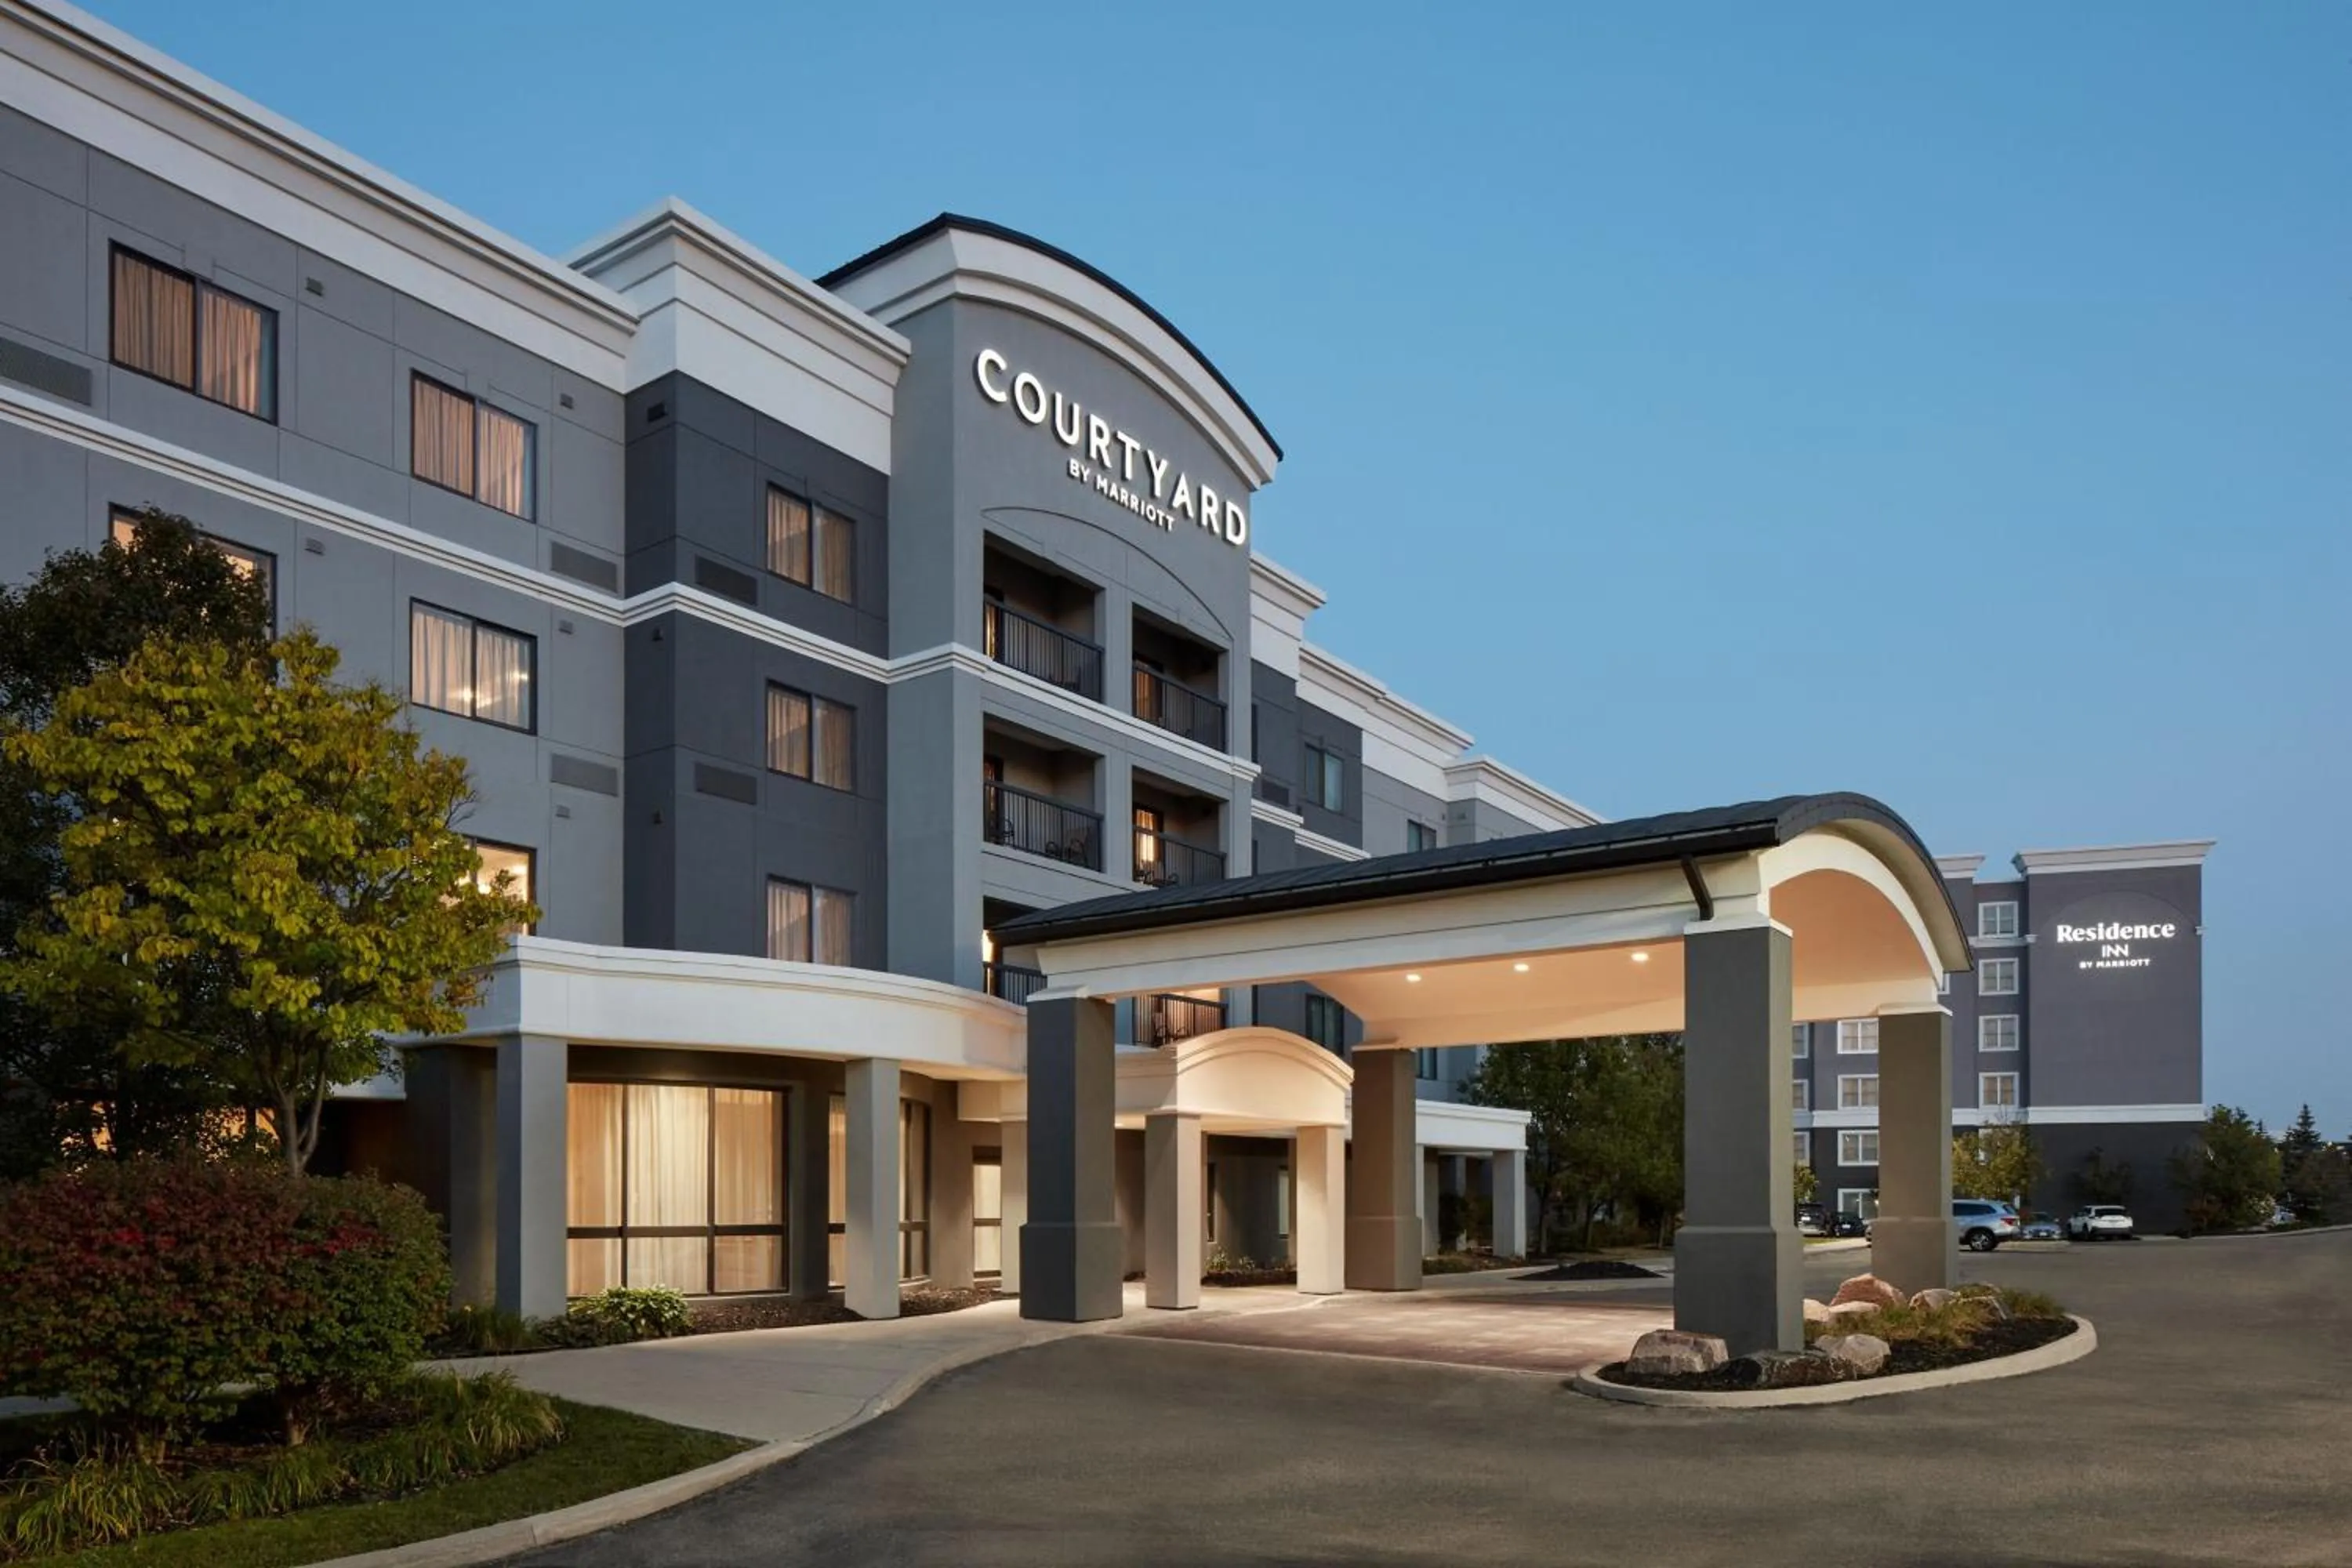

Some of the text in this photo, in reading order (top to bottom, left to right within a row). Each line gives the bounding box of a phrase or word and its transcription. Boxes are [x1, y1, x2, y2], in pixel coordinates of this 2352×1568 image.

[977, 349, 1247, 546] COURTYARD
[1068, 458, 1175, 532] BY MARRIOTT
[2056, 922, 2176, 943] Residence
[2102, 944, 2129, 958] INN
[2079, 958, 2151, 969] BY MARRIOTT
